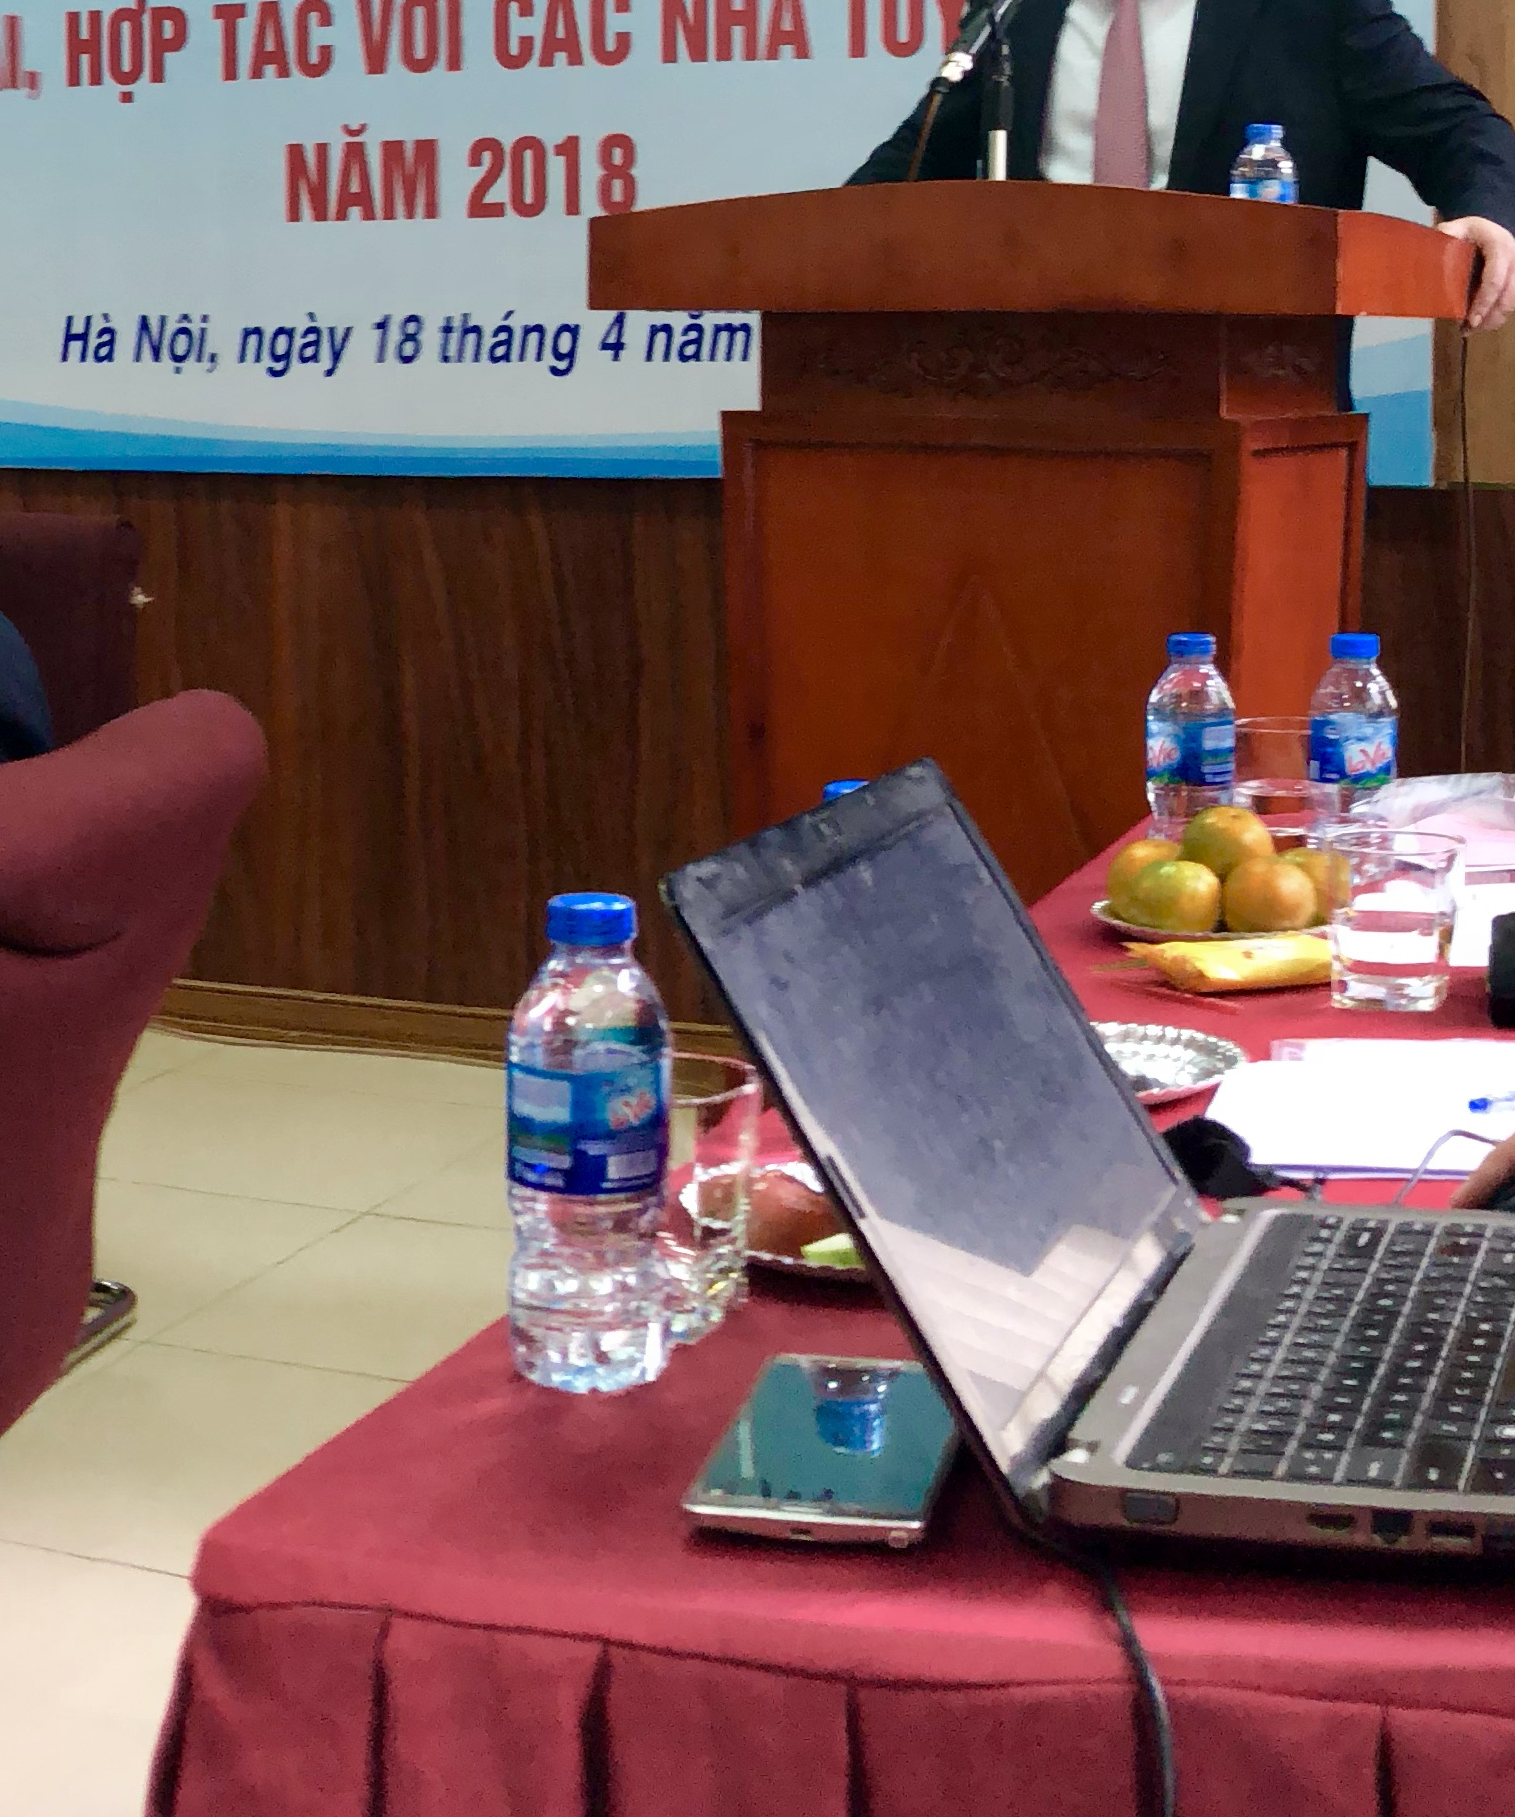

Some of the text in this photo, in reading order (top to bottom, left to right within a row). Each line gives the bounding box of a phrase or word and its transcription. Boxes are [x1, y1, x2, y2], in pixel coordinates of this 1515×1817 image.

[284, 124, 638, 223] NĂM 2018
[60, 308, 755, 379] Hà Nội, ngày 18 tháng 4 năm
